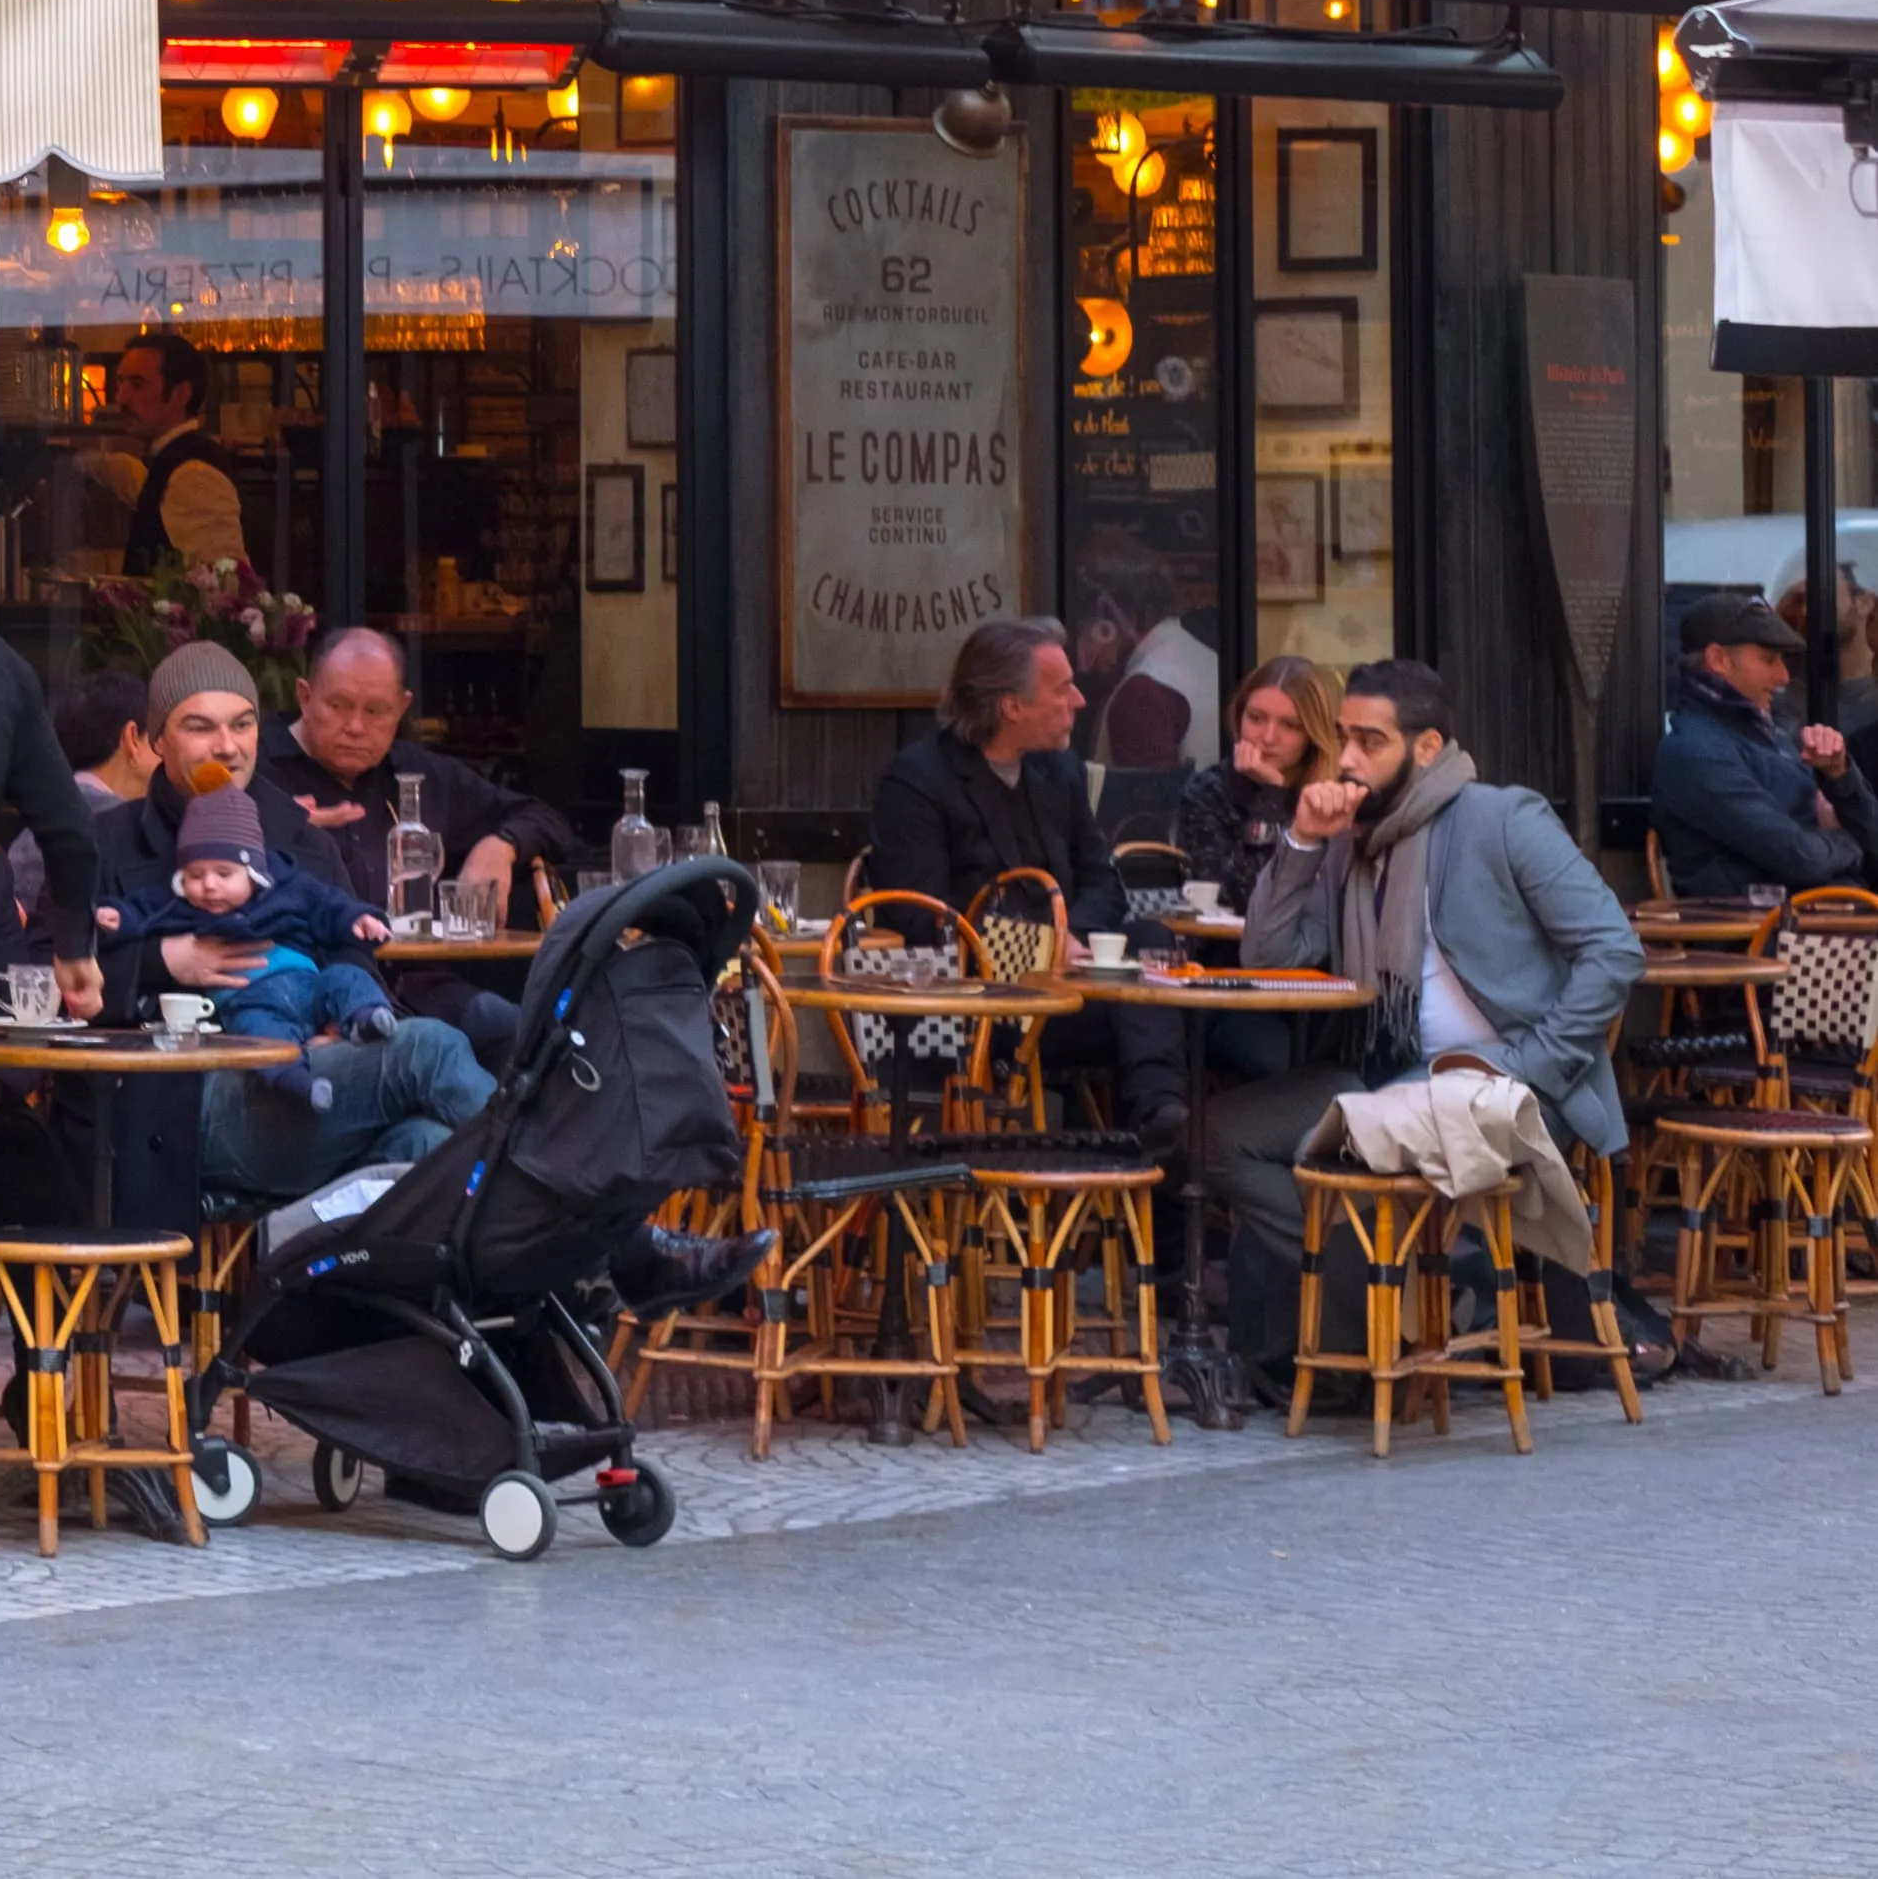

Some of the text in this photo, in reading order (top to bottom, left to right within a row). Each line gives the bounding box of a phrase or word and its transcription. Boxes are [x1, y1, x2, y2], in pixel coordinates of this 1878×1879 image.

[826, 178, 985, 237] COCKTAILS
[880, 256, 933, 294] 62
[822, 303, 990, 325] RUE MONTORGUEIL
[858, 350, 957, 371] CAFE-BAR
[840, 379, 974, 402] RESTAURANT
[805, 429, 846, 485] LE
[860, 430, 1007, 486] COMPAS
[870, 506, 945, 525] SERVICE
[868, 524, 948, 546] CONTINU
[811, 571, 1003, 634] CHAMPAGNES
